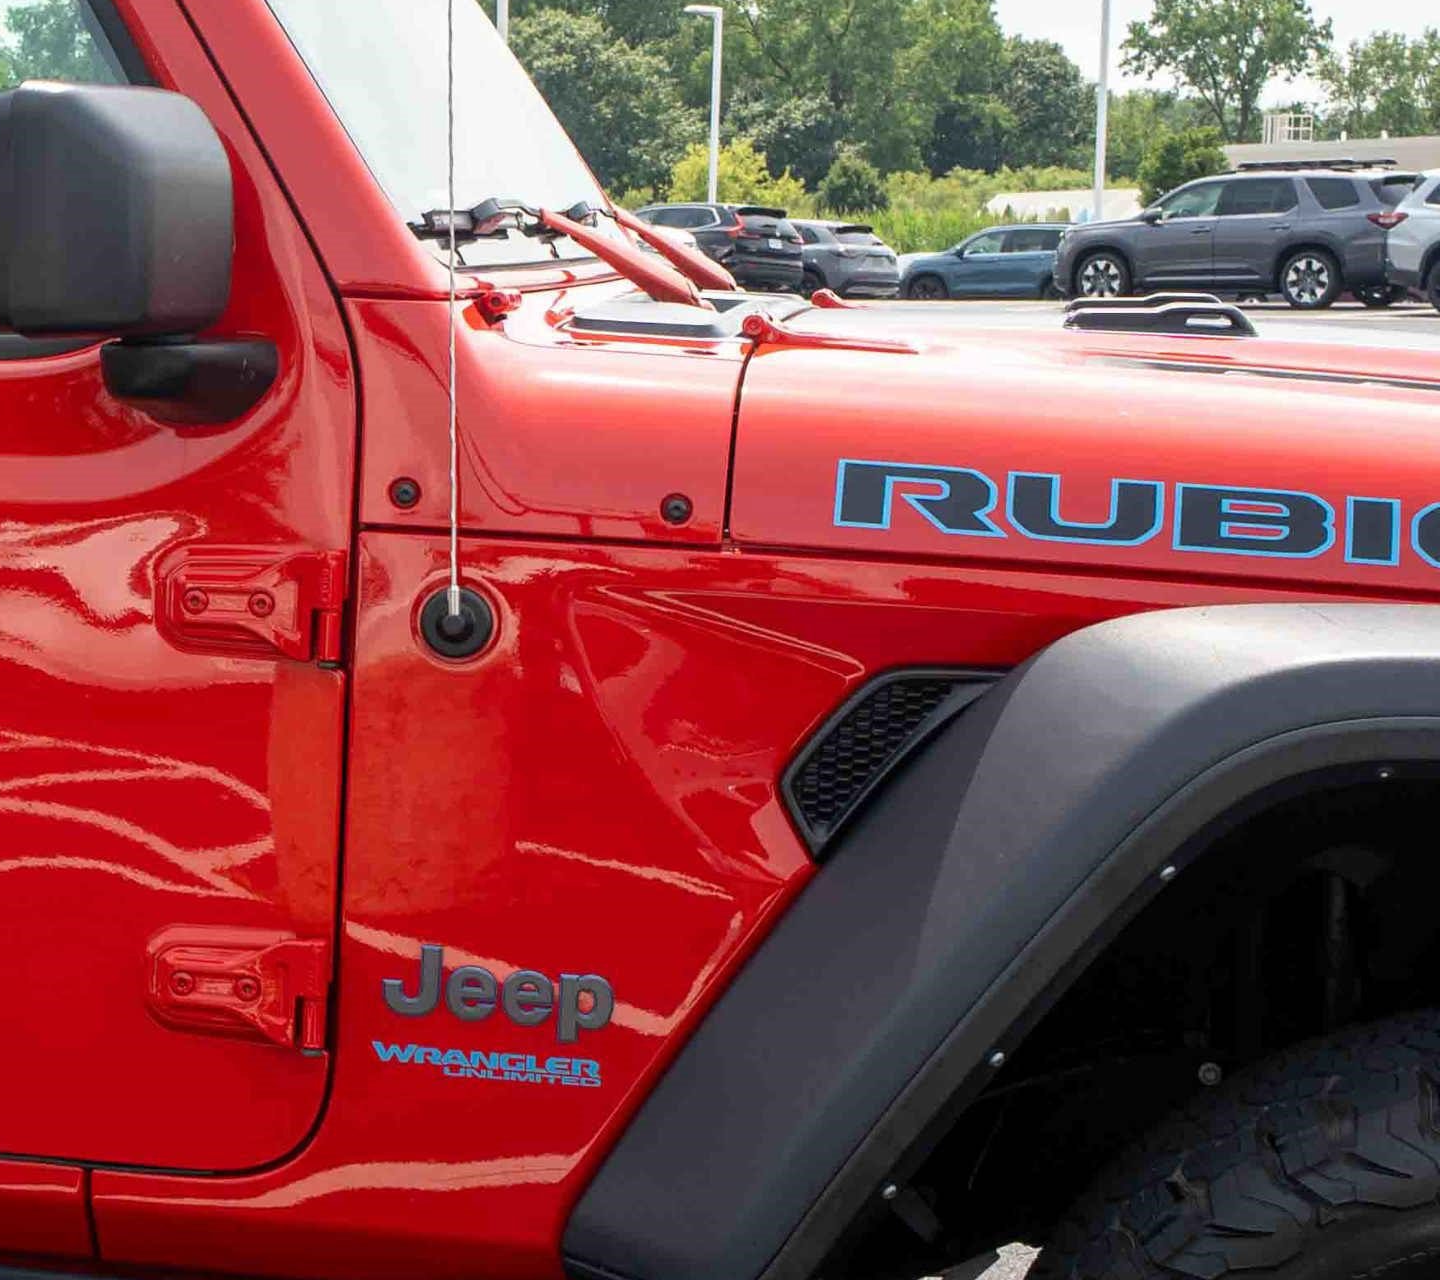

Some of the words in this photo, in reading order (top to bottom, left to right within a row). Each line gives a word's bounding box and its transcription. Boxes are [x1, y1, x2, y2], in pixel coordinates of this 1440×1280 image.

[382, 942, 614, 1044] Jeep
[372, 1040, 601, 1077] WRANGLER
[442, 1065, 602, 1087] UNLIMITED
